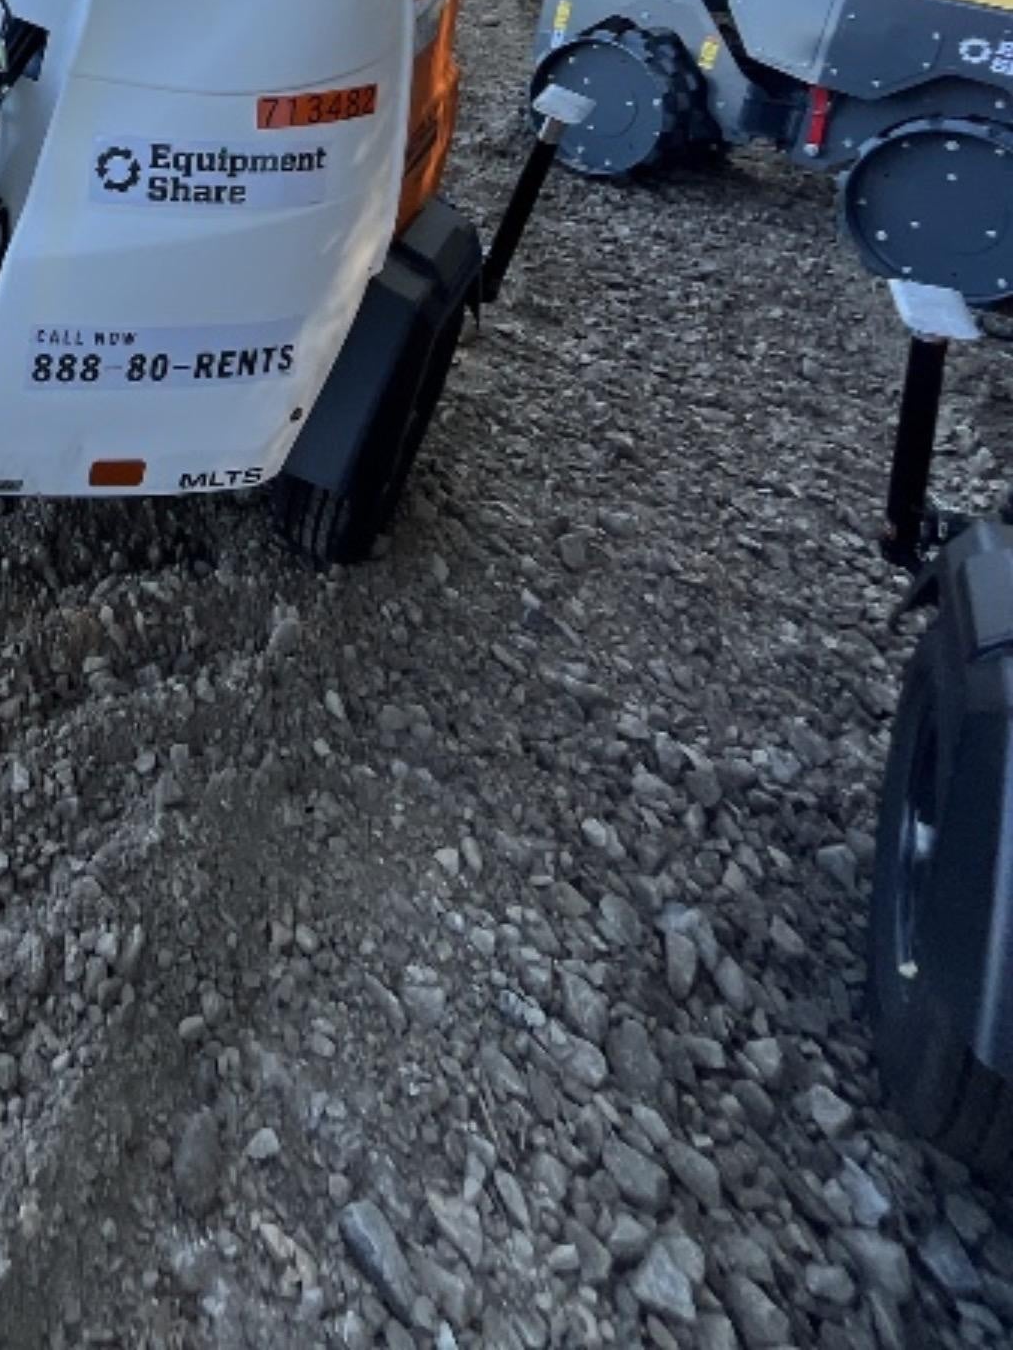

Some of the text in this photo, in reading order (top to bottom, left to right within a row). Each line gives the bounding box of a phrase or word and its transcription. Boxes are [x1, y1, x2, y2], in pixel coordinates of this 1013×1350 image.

[258, 85, 376, 127] 713482
[149, 143, 327, 178] Equipment
[147, 176, 247, 204] Share
[36, 329, 138, 346] CALL NOW
[31, 344, 294, 382] 888-80-RENTS
[179, 467, 263, 490] MLTS
